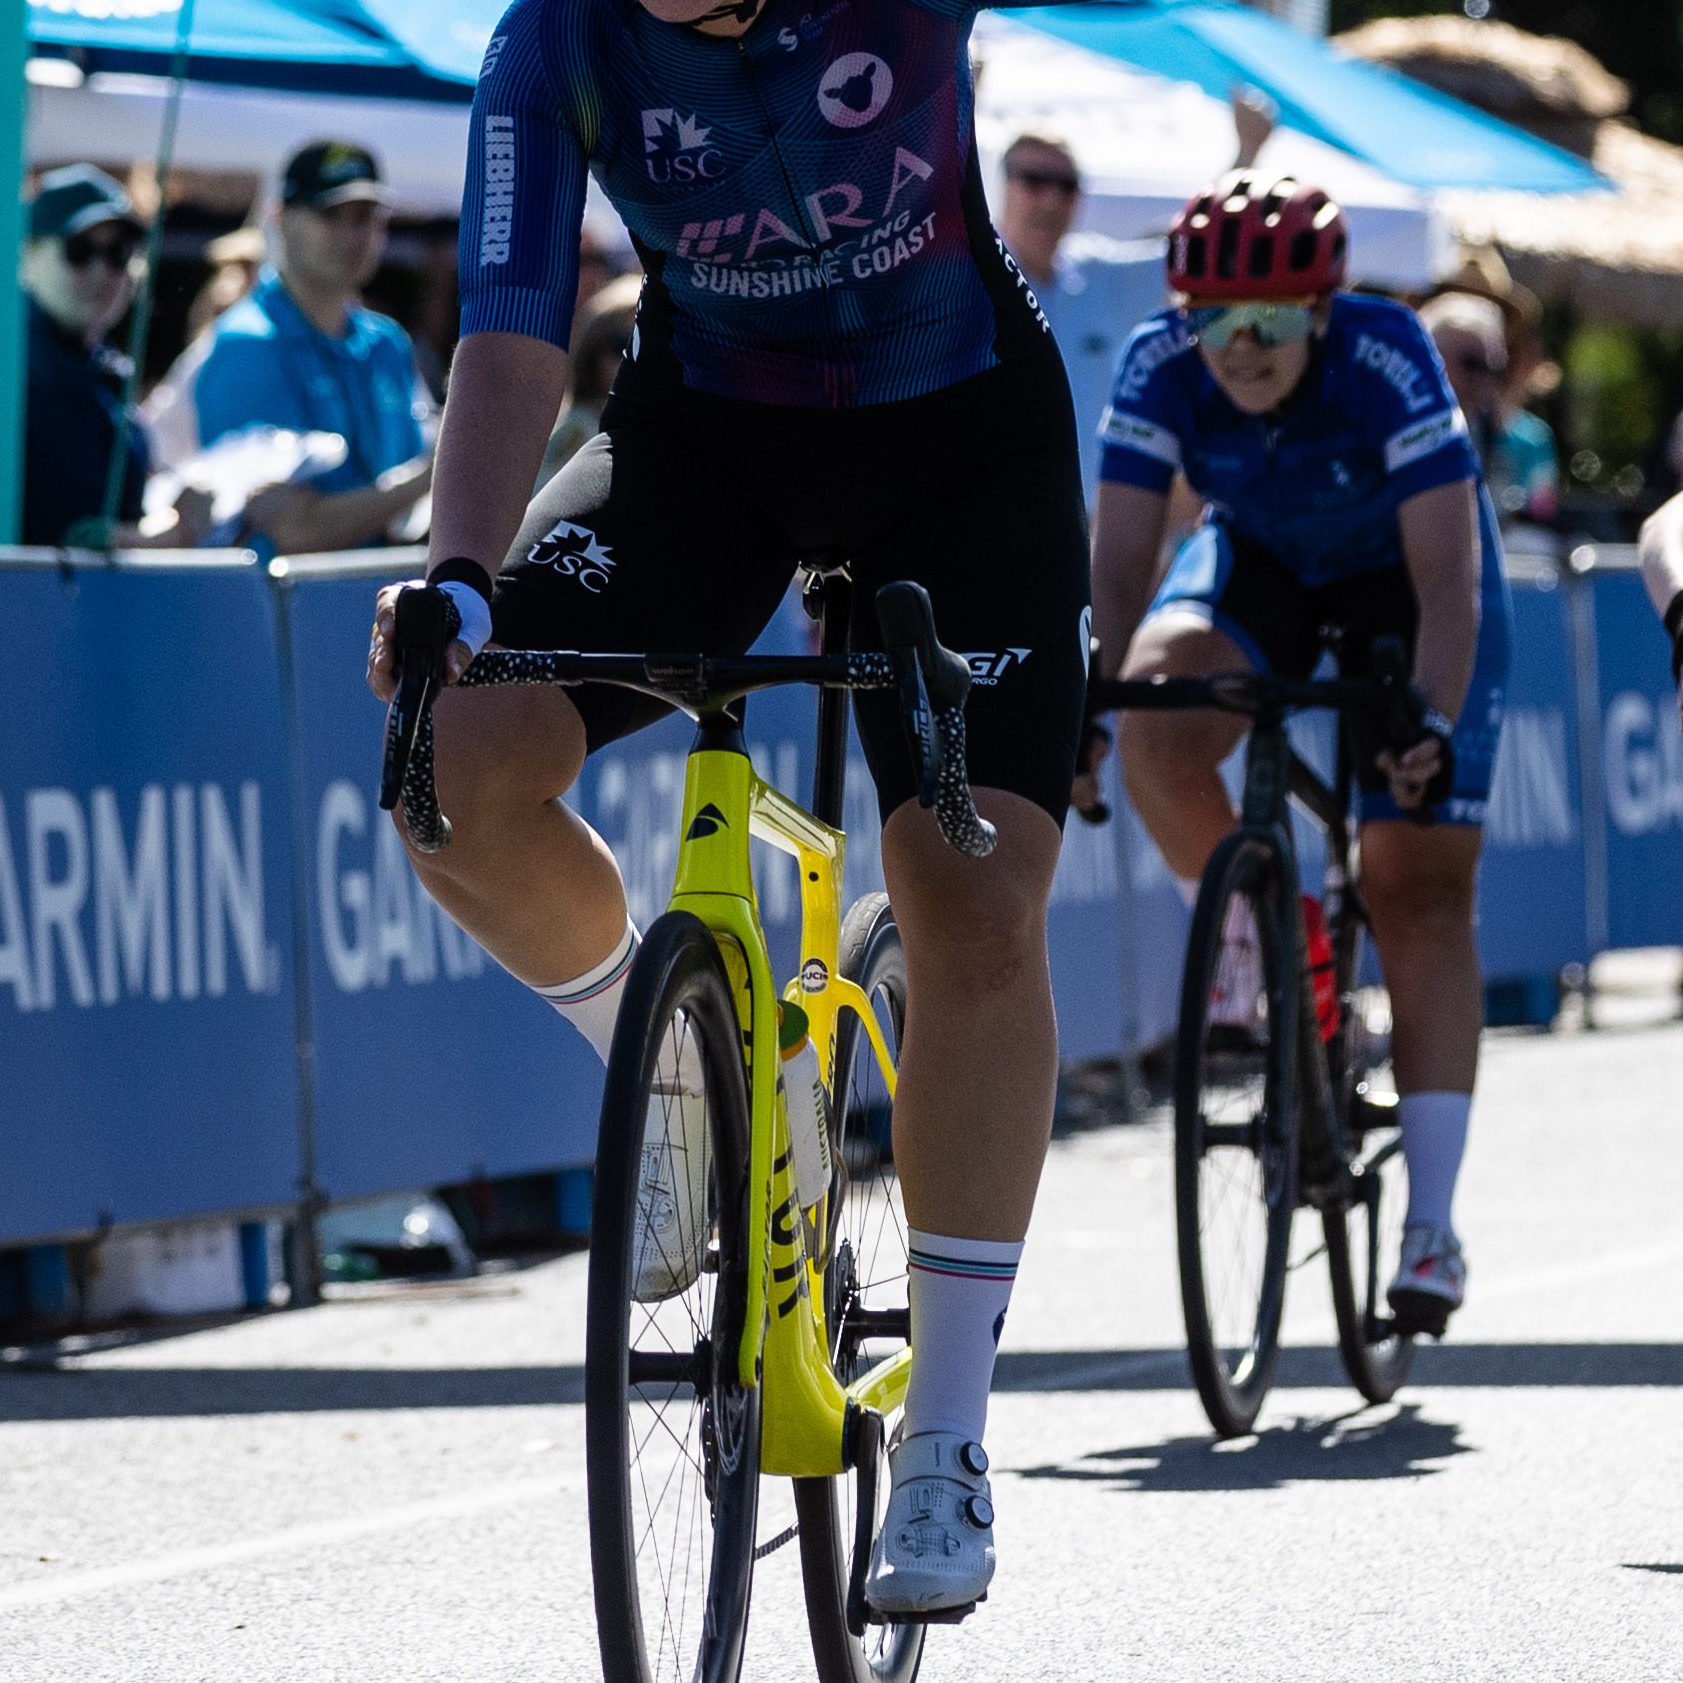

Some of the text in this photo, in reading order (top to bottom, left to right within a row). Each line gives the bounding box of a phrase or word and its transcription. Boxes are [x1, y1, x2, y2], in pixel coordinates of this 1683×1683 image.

[645, 149, 726, 182] USC
[480, 115, 515, 267] LIEBHERR
[690, 211, 937, 298] SUNSHINE COAST
[528, 543, 609, 593] USC
[651, 665, 695, 676] wahoo
